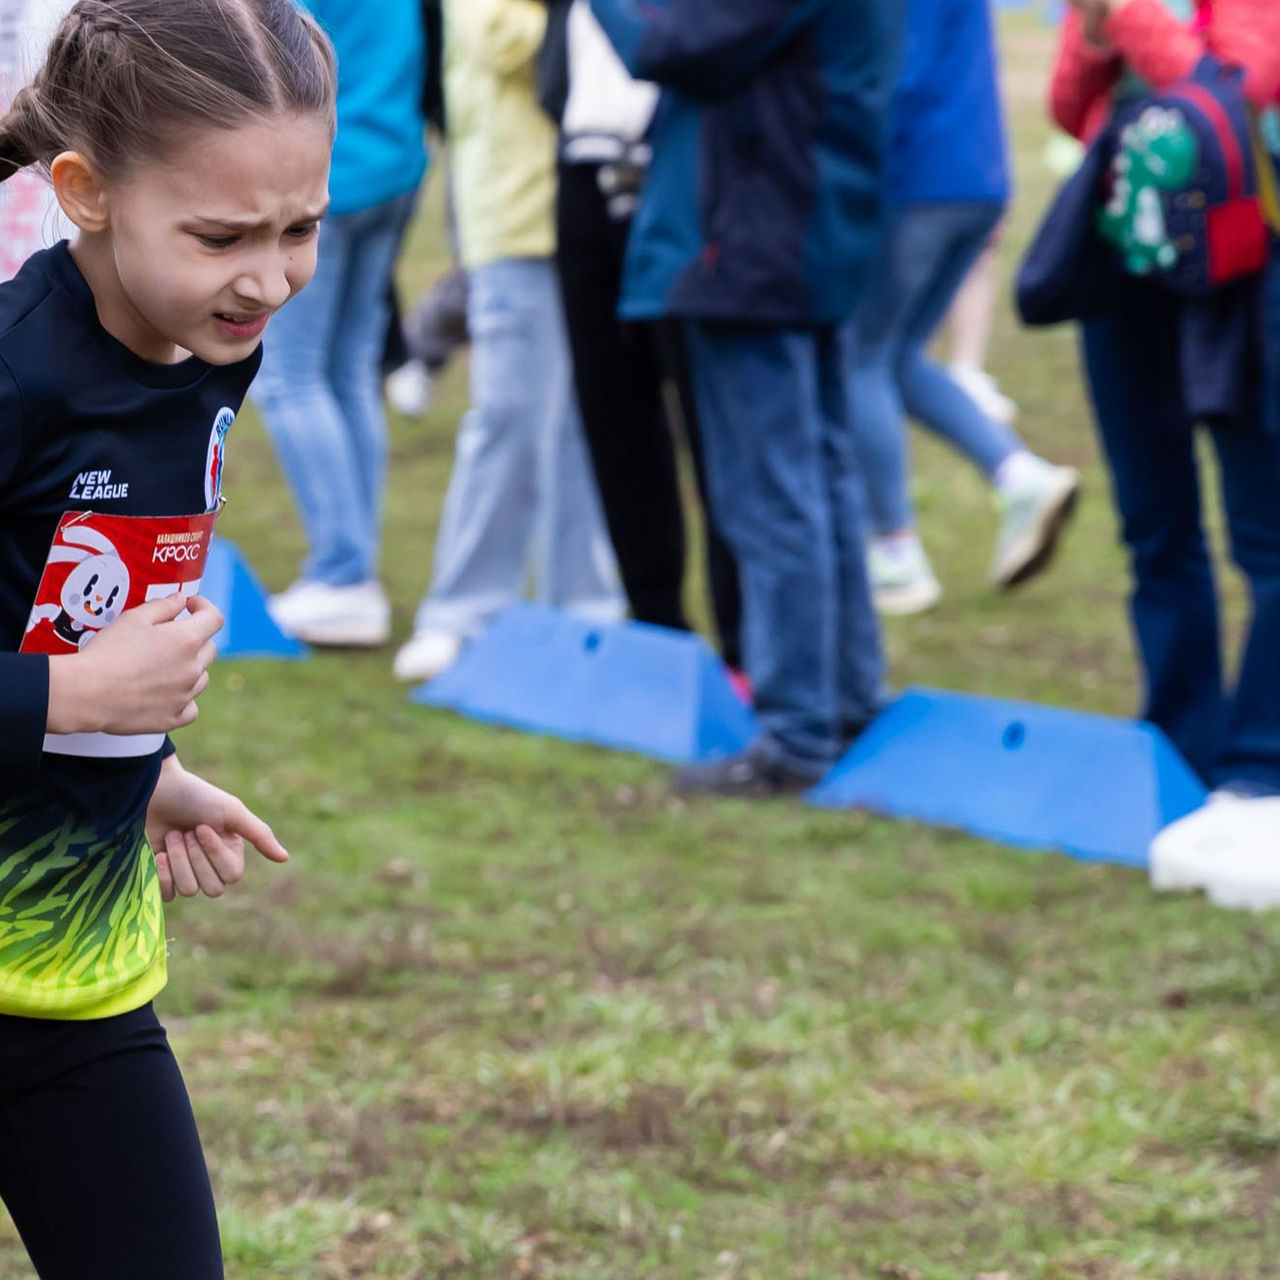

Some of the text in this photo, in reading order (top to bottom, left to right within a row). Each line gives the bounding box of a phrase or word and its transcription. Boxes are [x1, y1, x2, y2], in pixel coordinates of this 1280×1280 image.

[72, 469, 111, 488] NEW
[69, 483, 129, 500] LEAGUE
[152, 543, 201, 563] КРОСС
